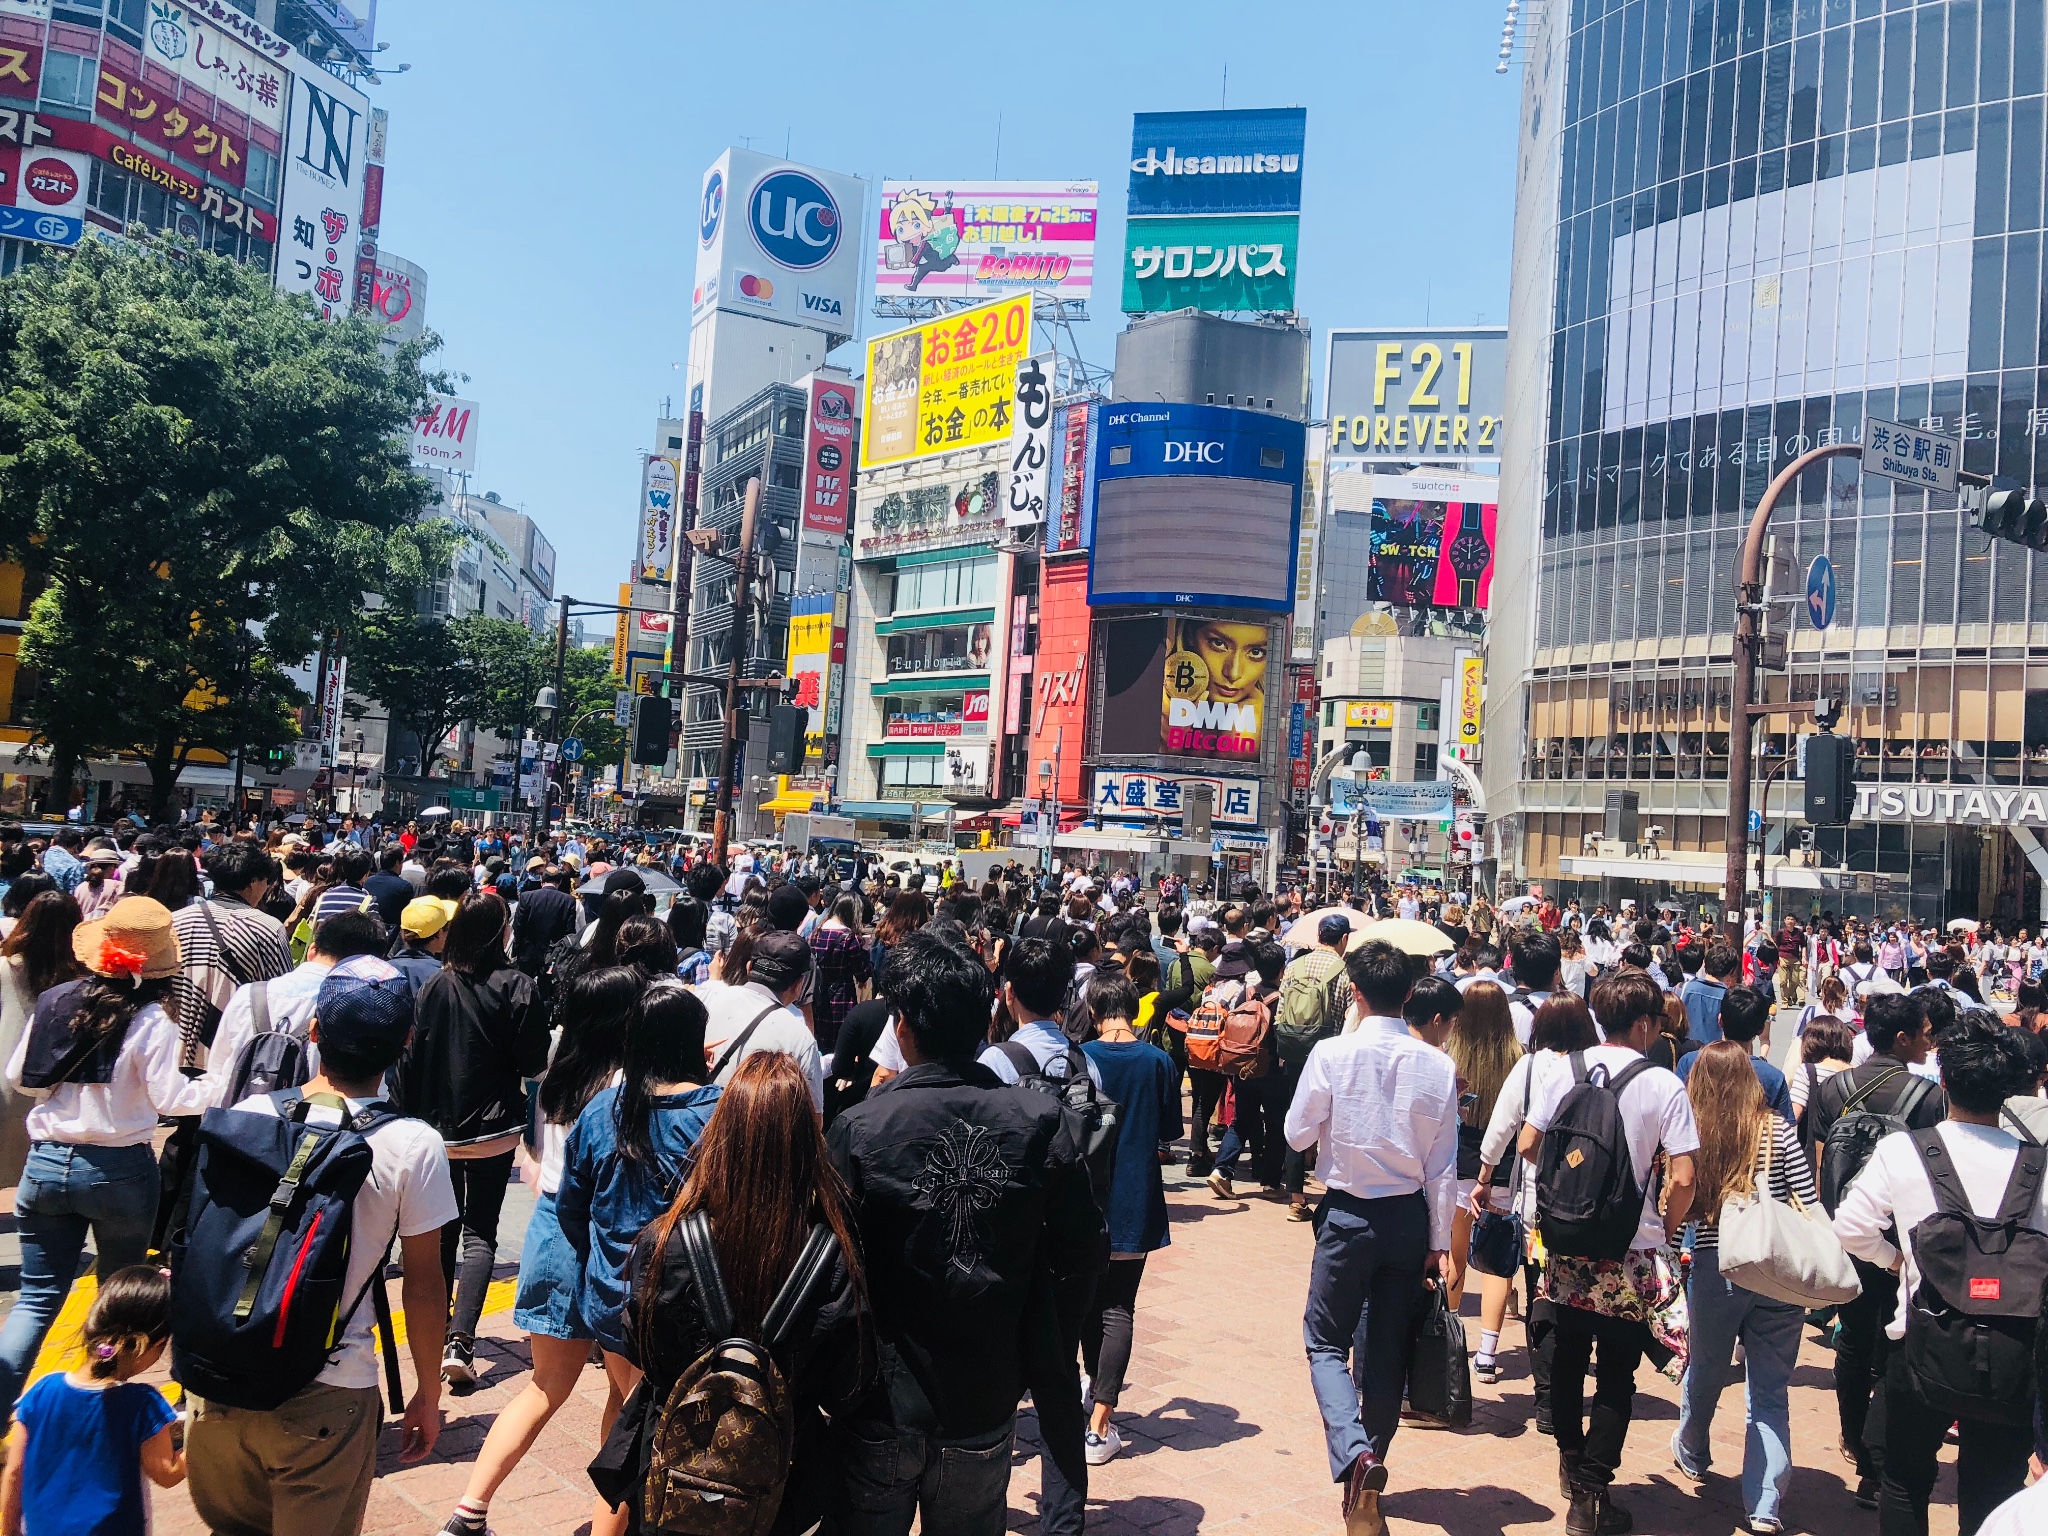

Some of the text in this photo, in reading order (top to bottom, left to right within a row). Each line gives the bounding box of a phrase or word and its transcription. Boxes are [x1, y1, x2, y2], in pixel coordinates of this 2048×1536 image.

[196, 33, 279, 108] しゃぶ葉
[98, 70, 240, 168] コンタクト
[1130, 147, 1299, 176] Hisamitsu
[32, 176, 73, 194] ガスト
[201, 187, 264, 234] ガスト
[38, 220, 64, 239] 6F
[1132, 244, 1286, 279] サロンパス
[802, 293, 842, 316] VISA
[924, 304, 1025, 368] お金2.0
[1374, 343, 1472, 405] F21
[872, 377, 918, 406] お金2.0
[1108, 411, 1171, 426] DHC Channel
[1333, 415, 1504, 446] FOREVER 2
[416, 444, 450, 459] 150m
[1010, 359, 1050, 520] もんじゃ
[1163, 442, 1225, 464] DHC
[1871, 425, 1952, 469] 渋谷駅前
[1882, 456, 1940, 483] Shibuya Sta.
[1411, 482, 1452, 491] swatch
[1175, 594, 1194, 603] DHC
[965, 694, 989, 716] JTB
[1169, 697, 1257, 733] DMM
[1166, 727, 1256, 753] Bitcoin
[1463, 724, 1476, 734] 4F
[1100, 779, 1251, 816] 大盛堂店
[1856, 787, 2048, 822] TSUTAYA
